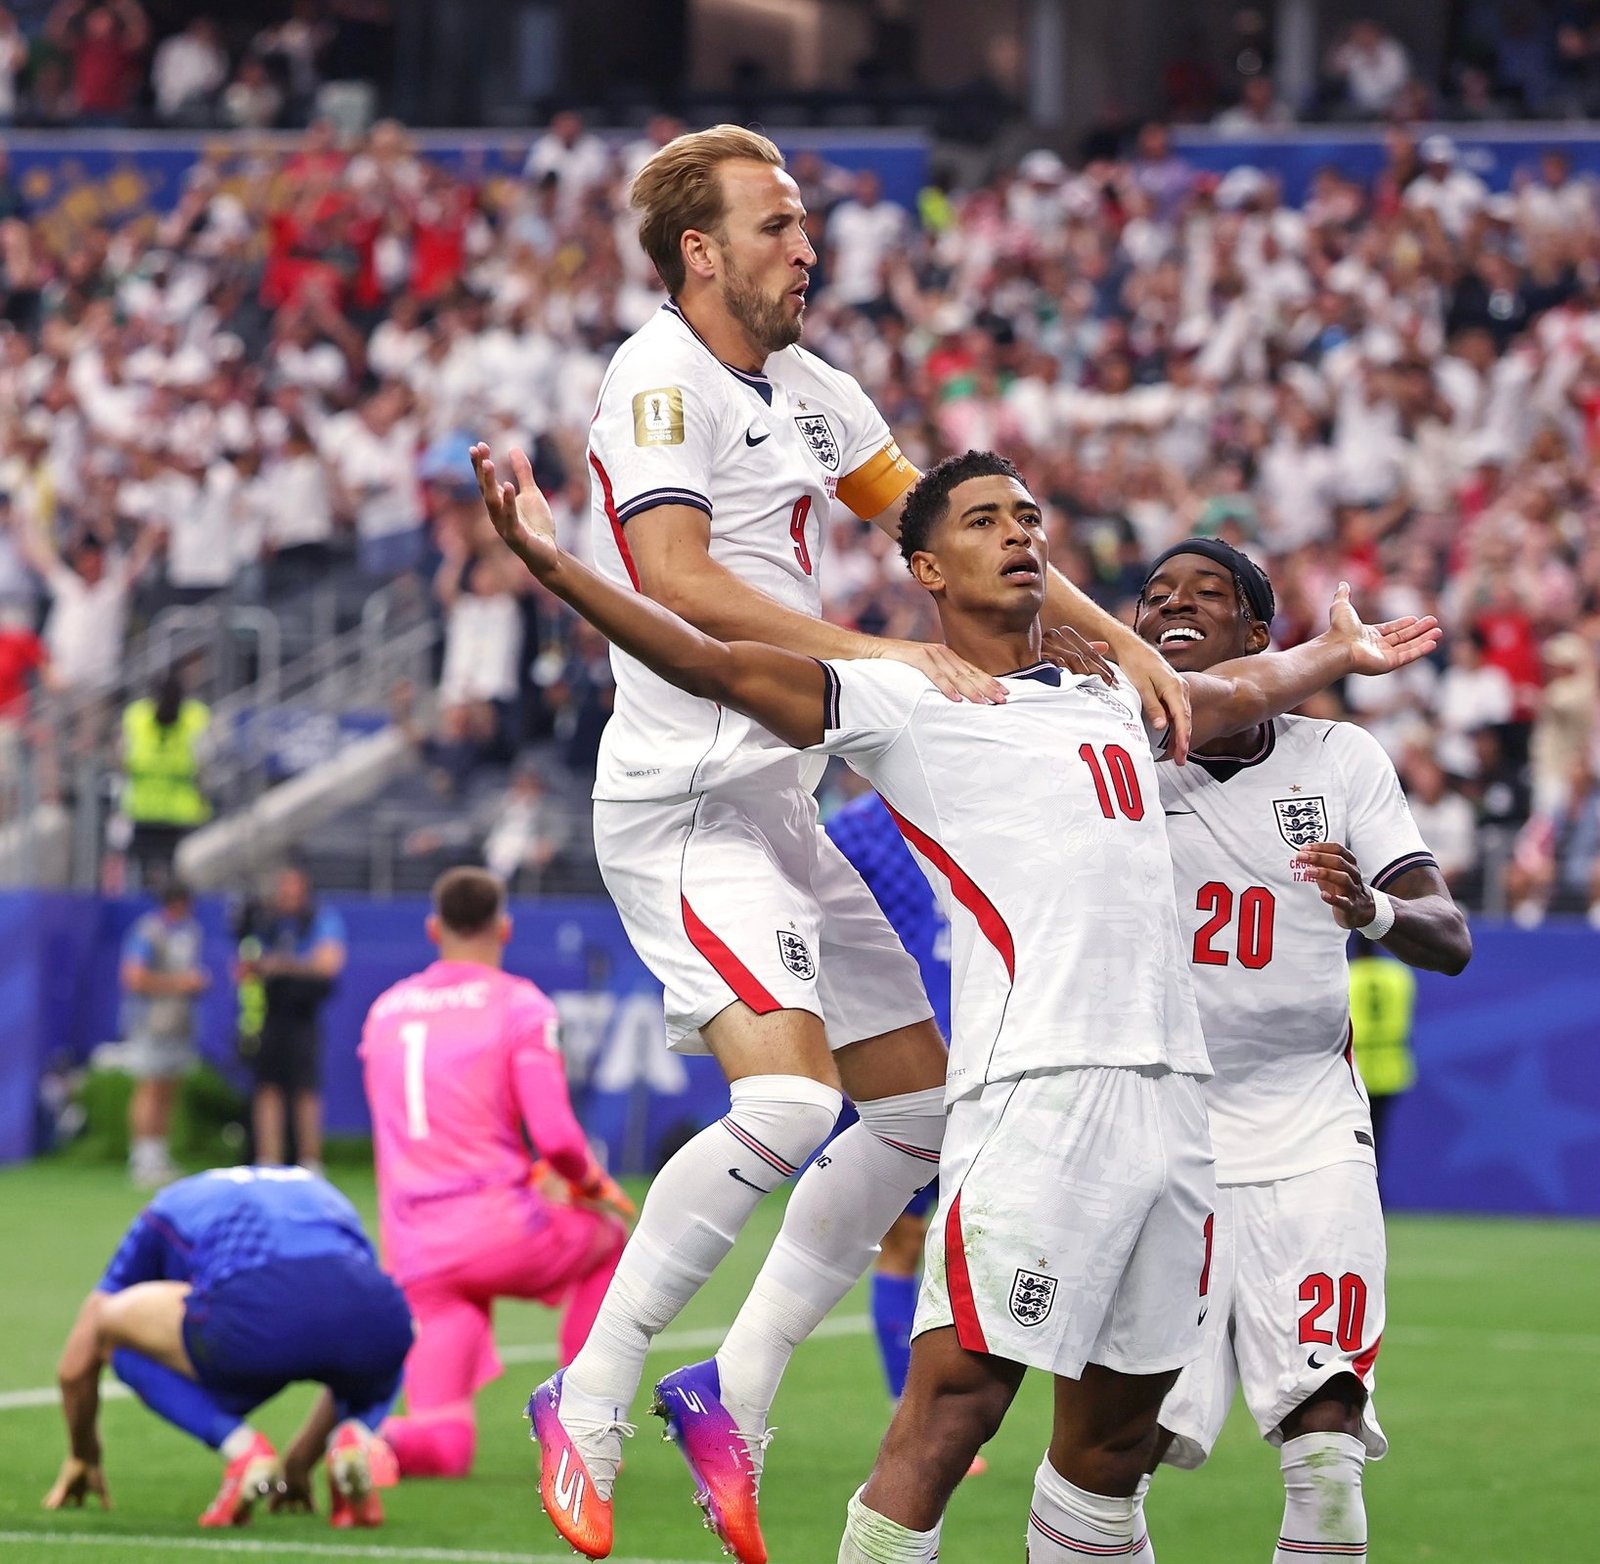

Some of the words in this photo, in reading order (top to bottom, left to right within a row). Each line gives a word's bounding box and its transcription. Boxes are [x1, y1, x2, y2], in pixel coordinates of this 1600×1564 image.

[790, 495, 812, 575] 9
[1078, 743, 1145, 822] 10
[1192, 881, 1276, 970] 20
[400, 1022, 430, 1139] 1
[1199, 1212, 1214, 1297] 1
[1298, 1271, 1367, 1353] 20
